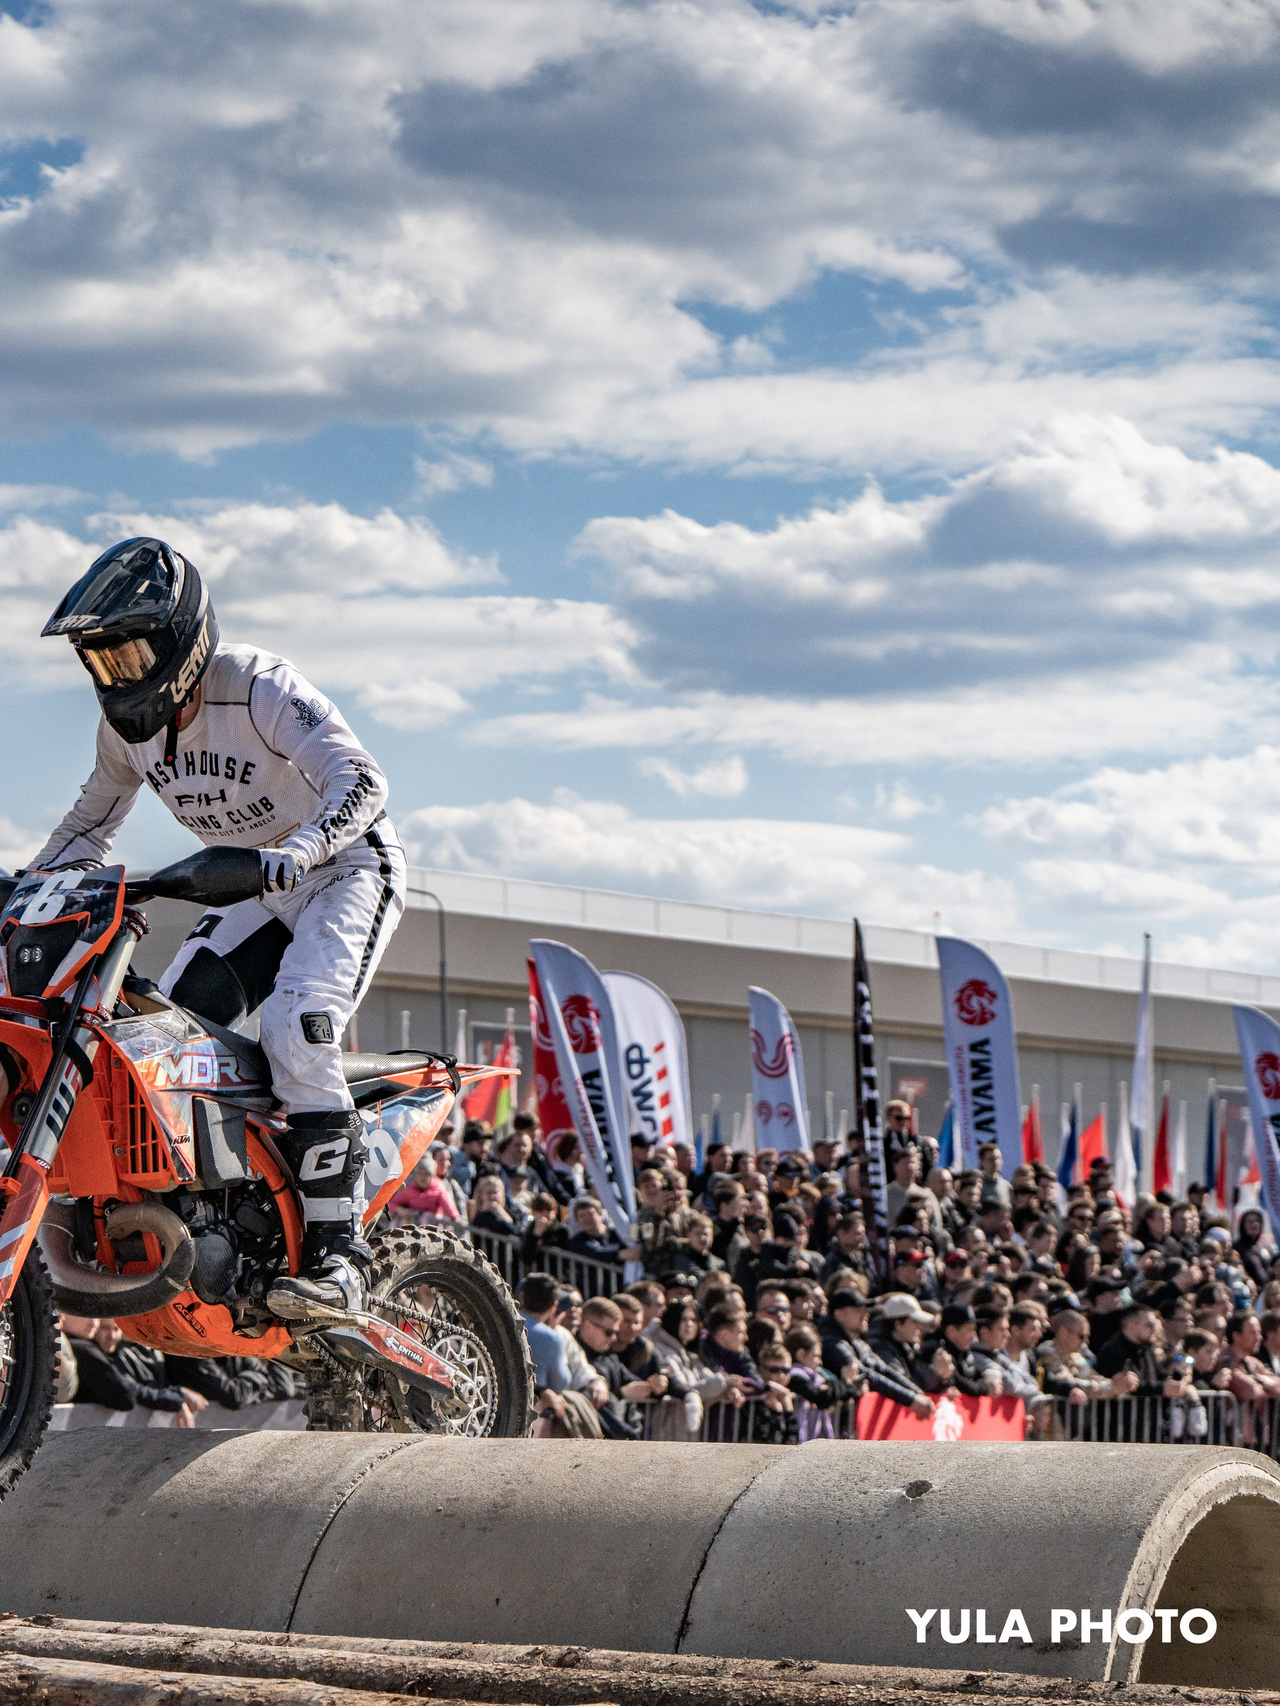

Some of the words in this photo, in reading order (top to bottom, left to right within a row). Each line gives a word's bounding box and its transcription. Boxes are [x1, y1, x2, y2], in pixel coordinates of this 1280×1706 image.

[170, 613, 211, 704] LEATT
[145, 750, 256, 793] ASTHOUSE
[173, 811, 222, 830] CING
[225, 796, 275, 825] CLUB
[219, 829, 235, 837] CITY
[237, 826, 246, 834] OF
[249, 814, 276, 830] ANGELS
[19, 871, 86, 925] 6
[172, 1134, 191, 1146] KTM
